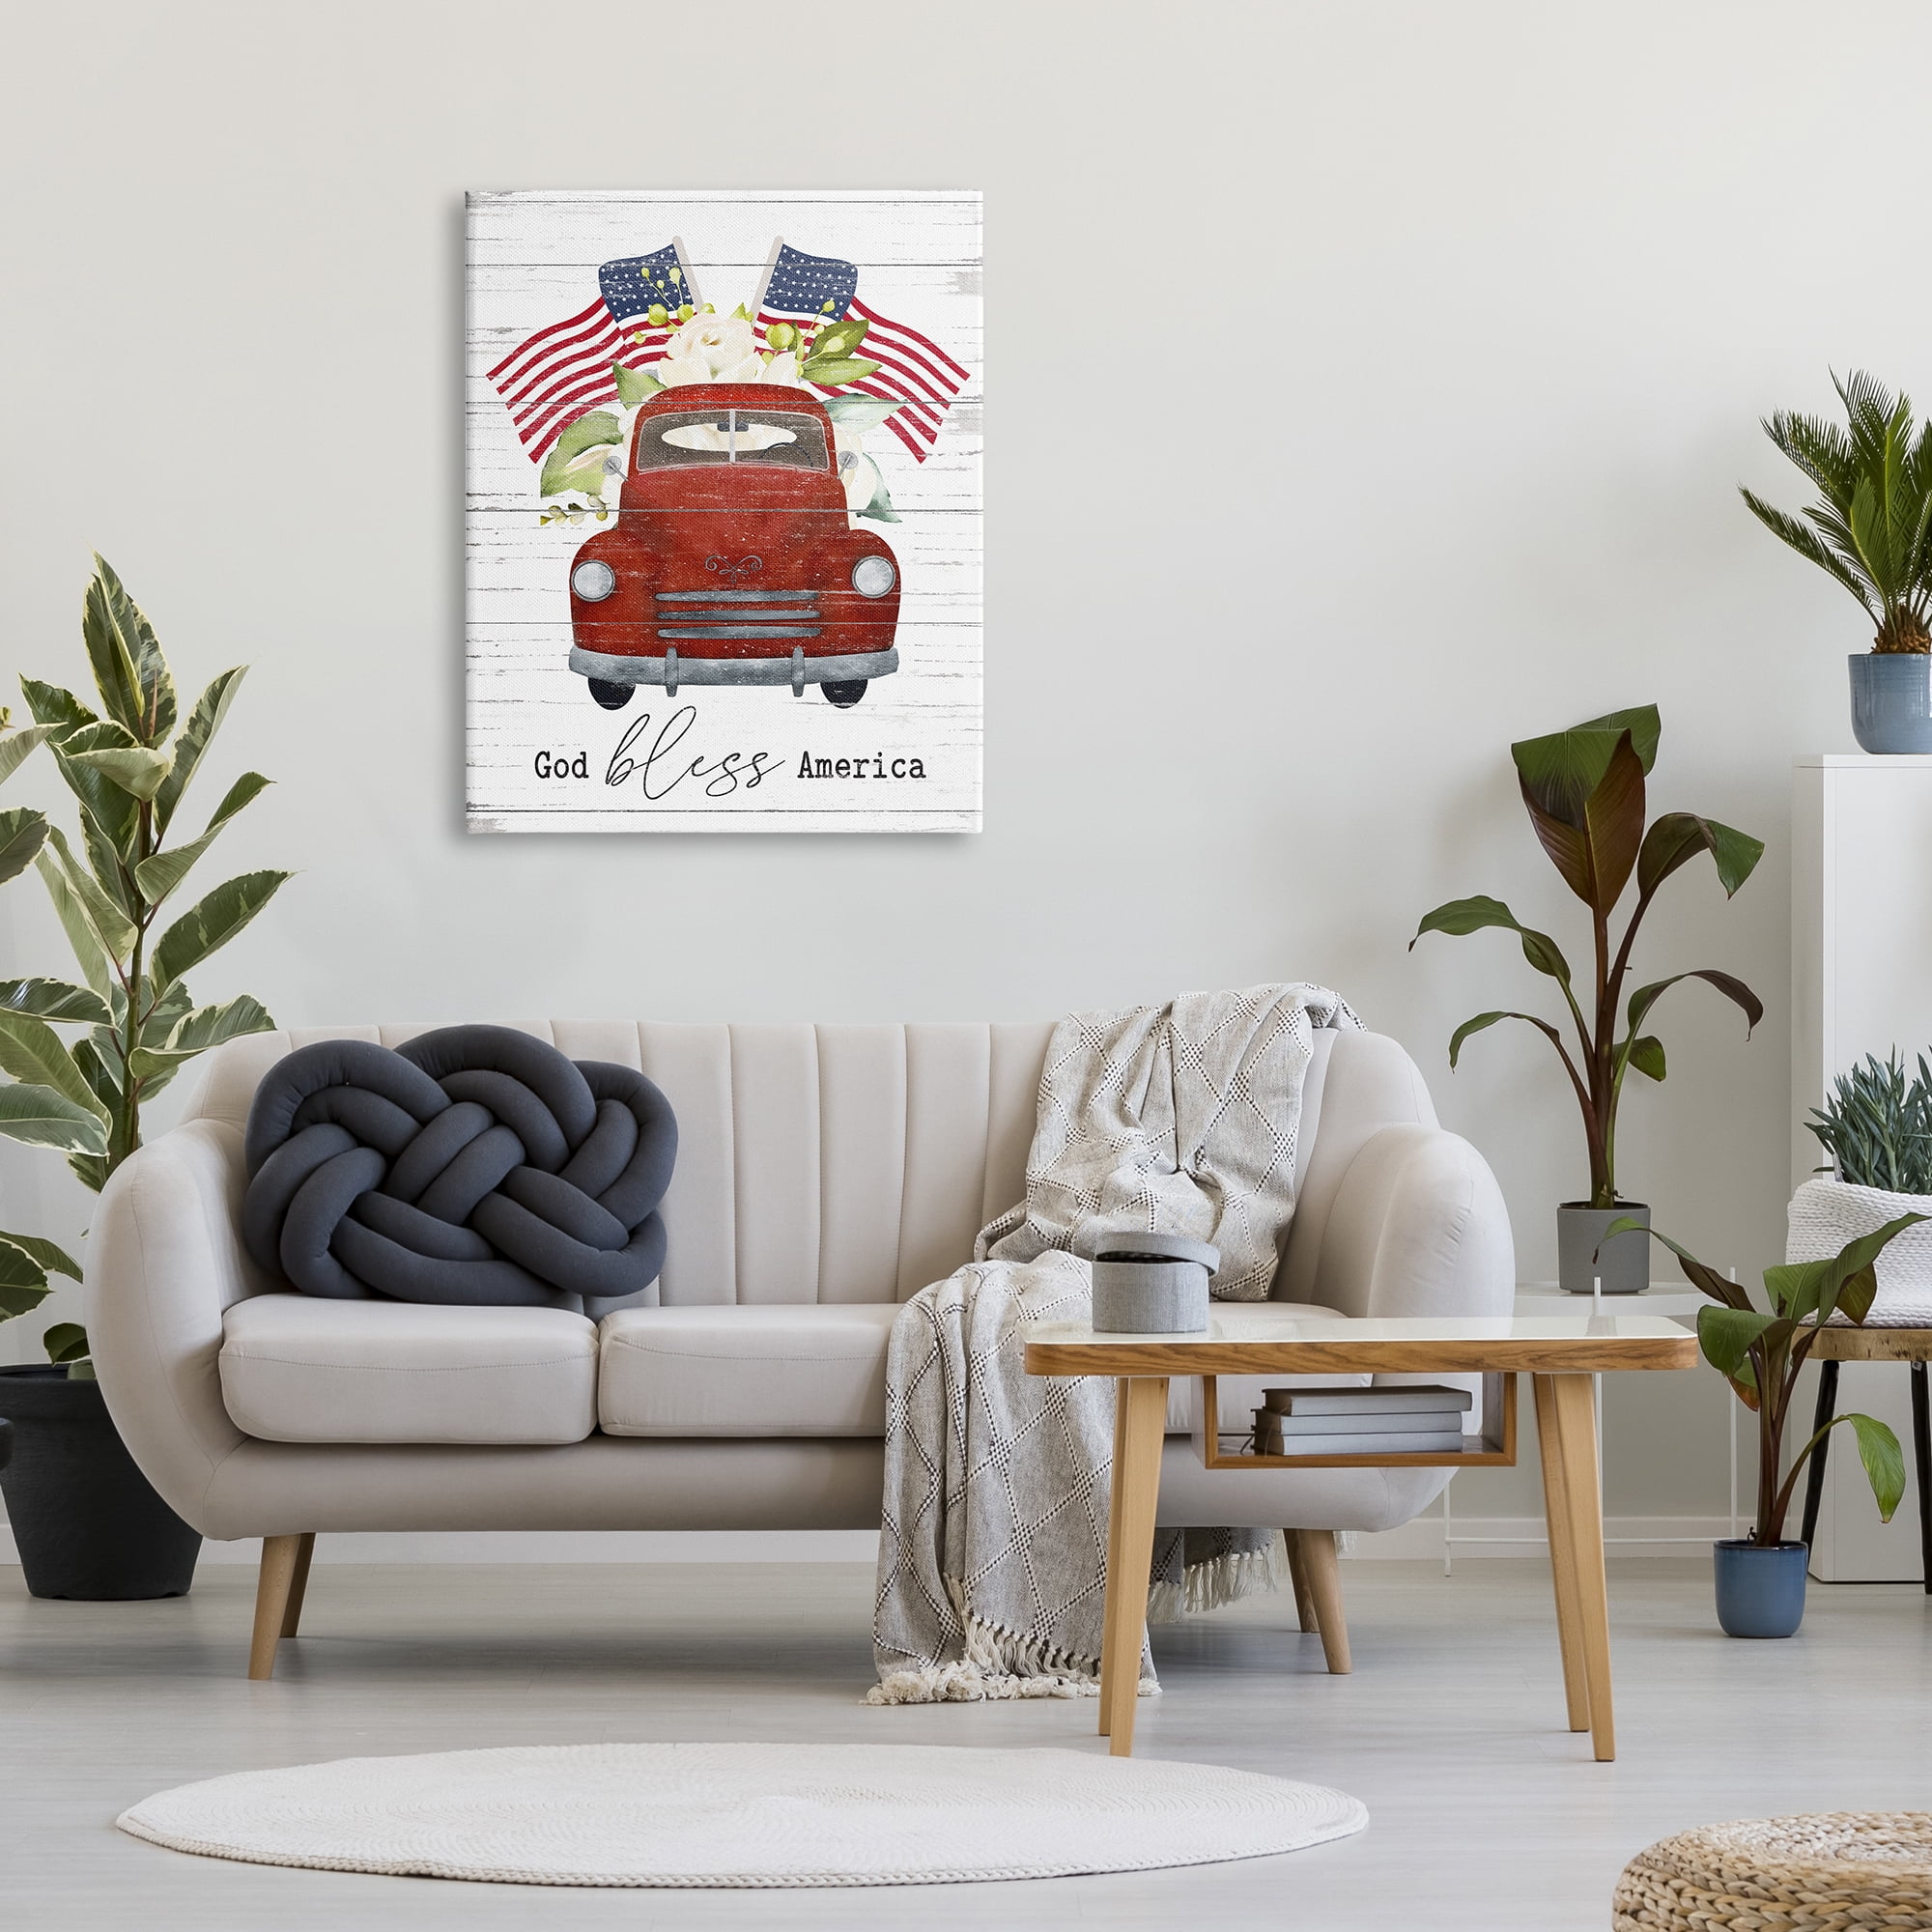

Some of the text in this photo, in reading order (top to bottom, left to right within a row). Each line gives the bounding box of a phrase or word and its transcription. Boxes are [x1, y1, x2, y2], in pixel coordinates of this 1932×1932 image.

[534, 705, 926, 800] God bless America
